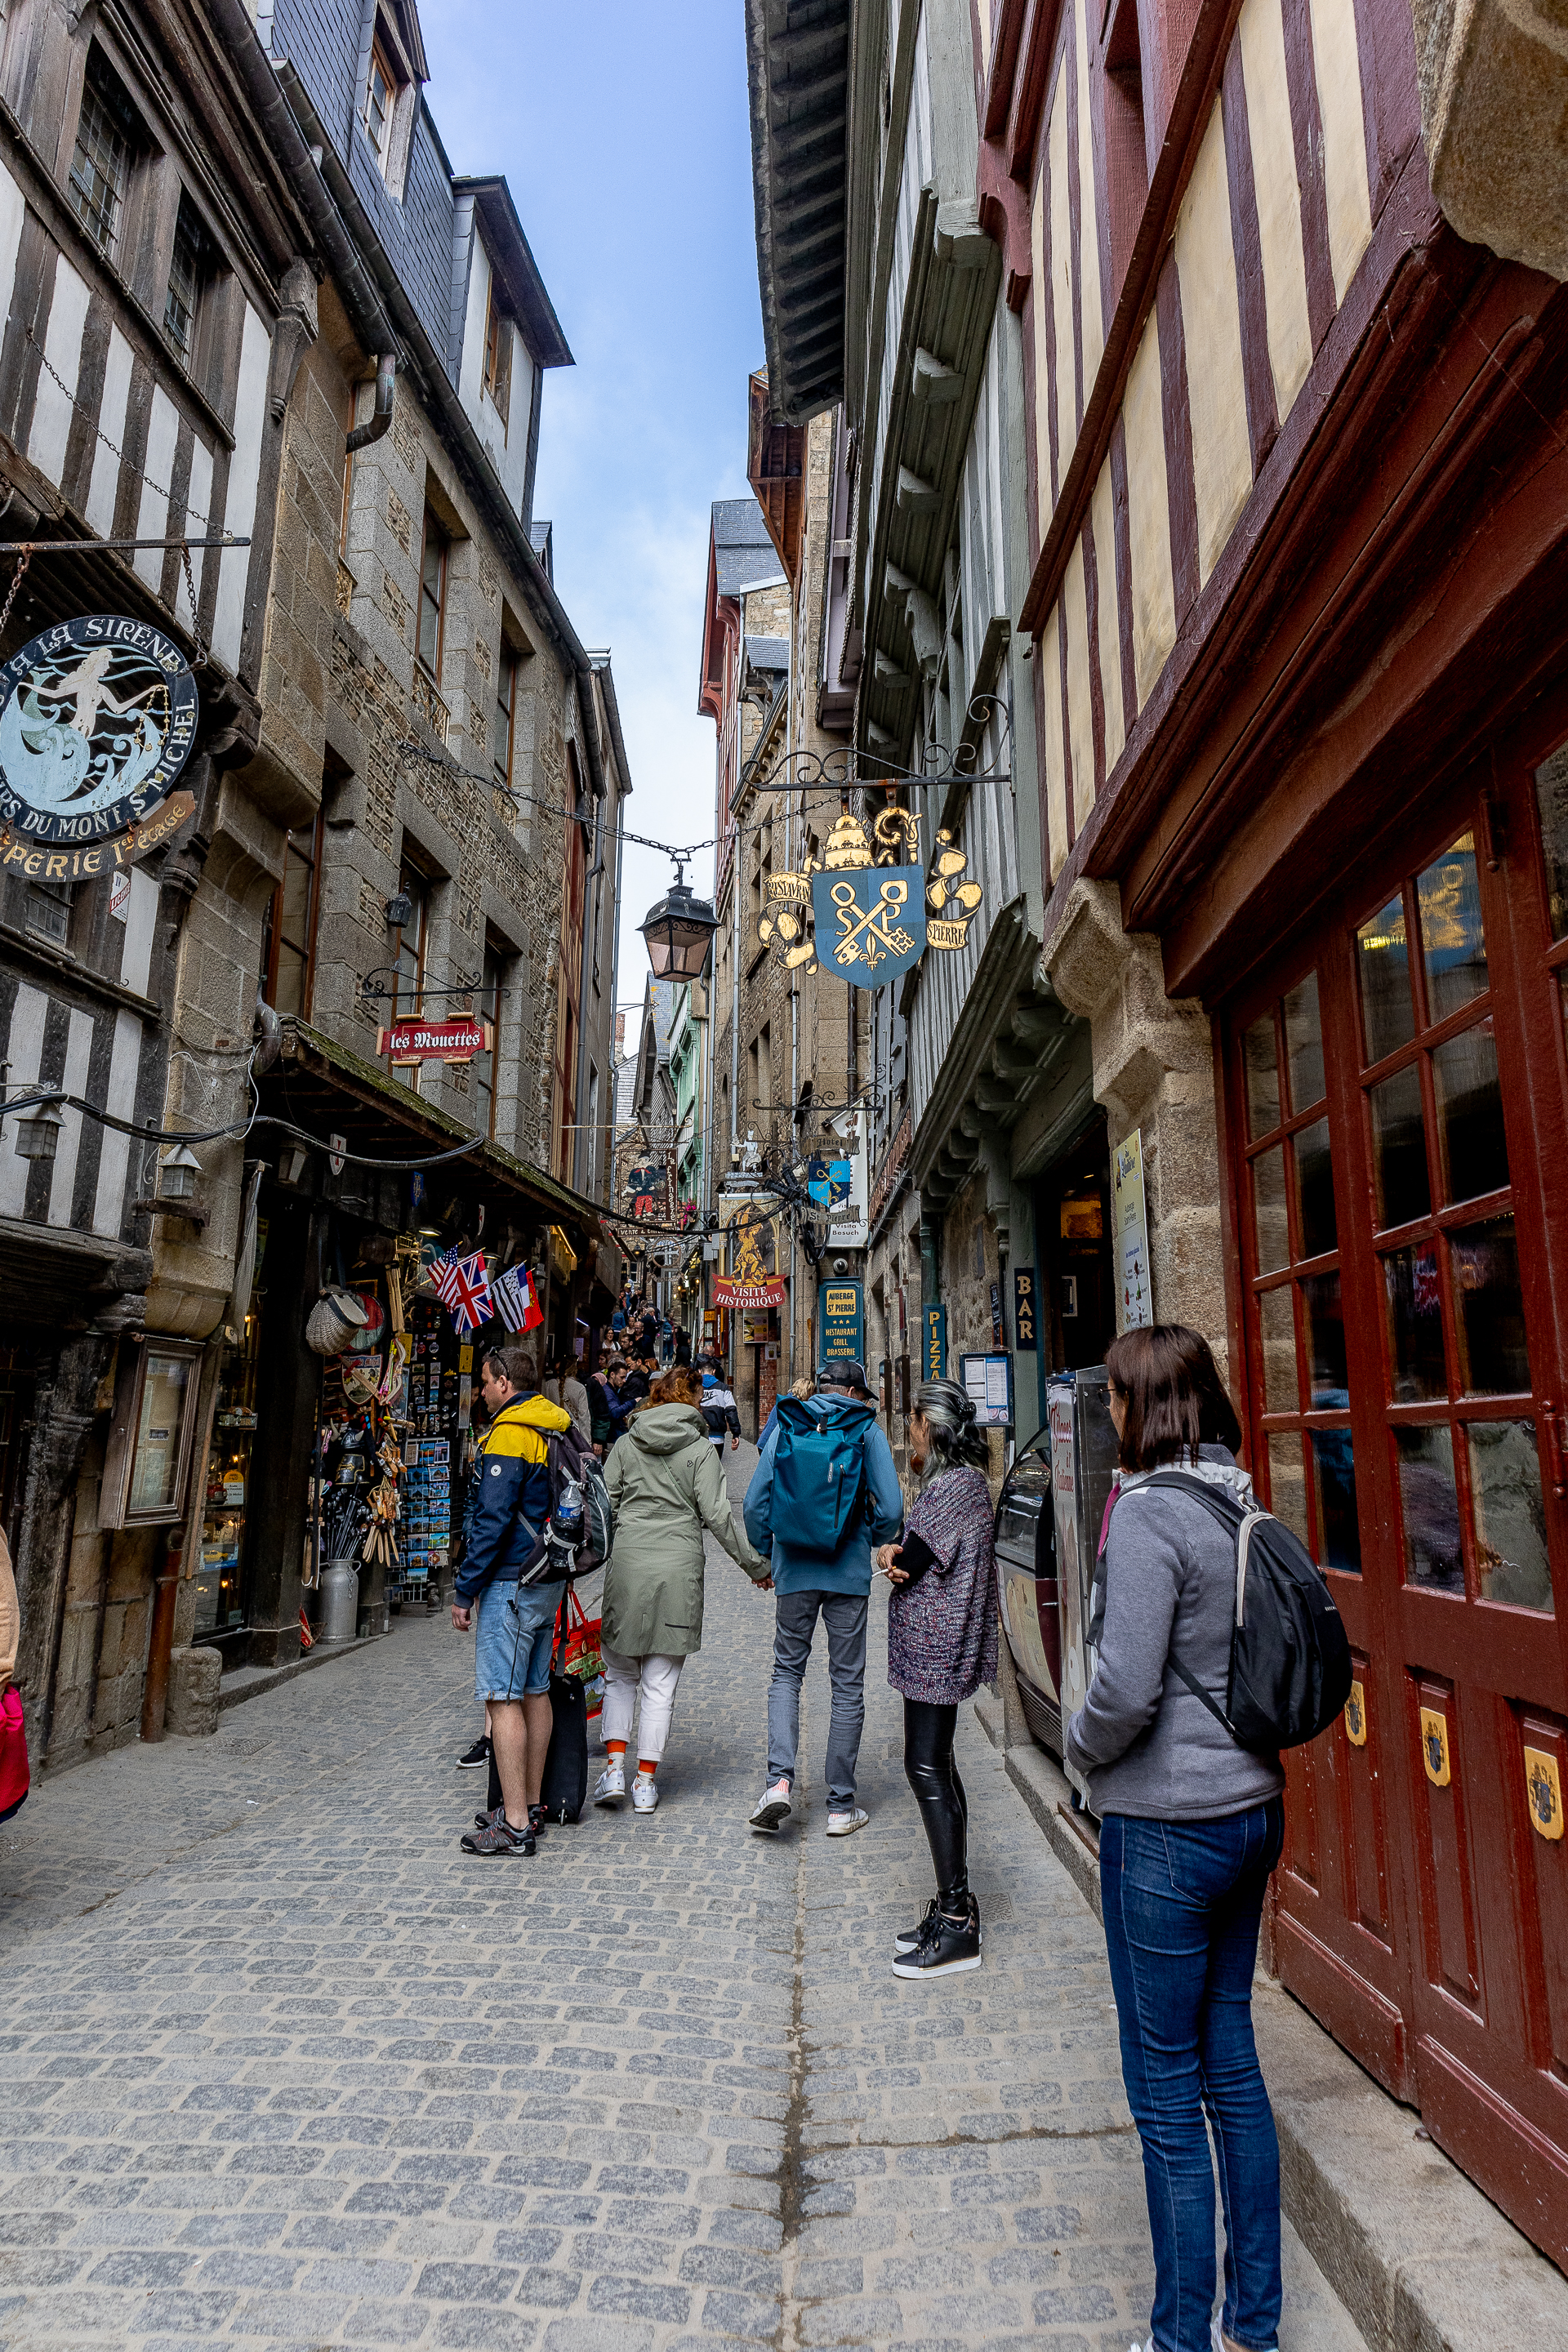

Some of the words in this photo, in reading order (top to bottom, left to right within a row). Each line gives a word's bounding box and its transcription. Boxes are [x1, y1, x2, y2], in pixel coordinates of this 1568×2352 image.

[11, 654, 34, 676] A
[38, 625, 74, 654] LA
[21, 810, 54, 835] DU
[58, 804, 121, 839] MONT
[148, 697, 195, 793] MICHEL
[390, 1032, 410, 1049] les
[413, 1031, 480, 1049] Mouettes
[826, 1214, 850, 1223] Pierre
[732, 1286, 768, 1297] VISITE
[828, 1292, 854, 1300] AUBERGE
[716, 1292, 782, 1307] HISTORIQUE
[835, 1303, 855, 1312] PIERRE
[1017, 1275, 1034, 1340] BAR
[825, 1327, 858, 1336] RESTAURANT
[826, 1348, 856, 1356] BRASSERIE
[929, 1311, 941, 1380] PIZZA
